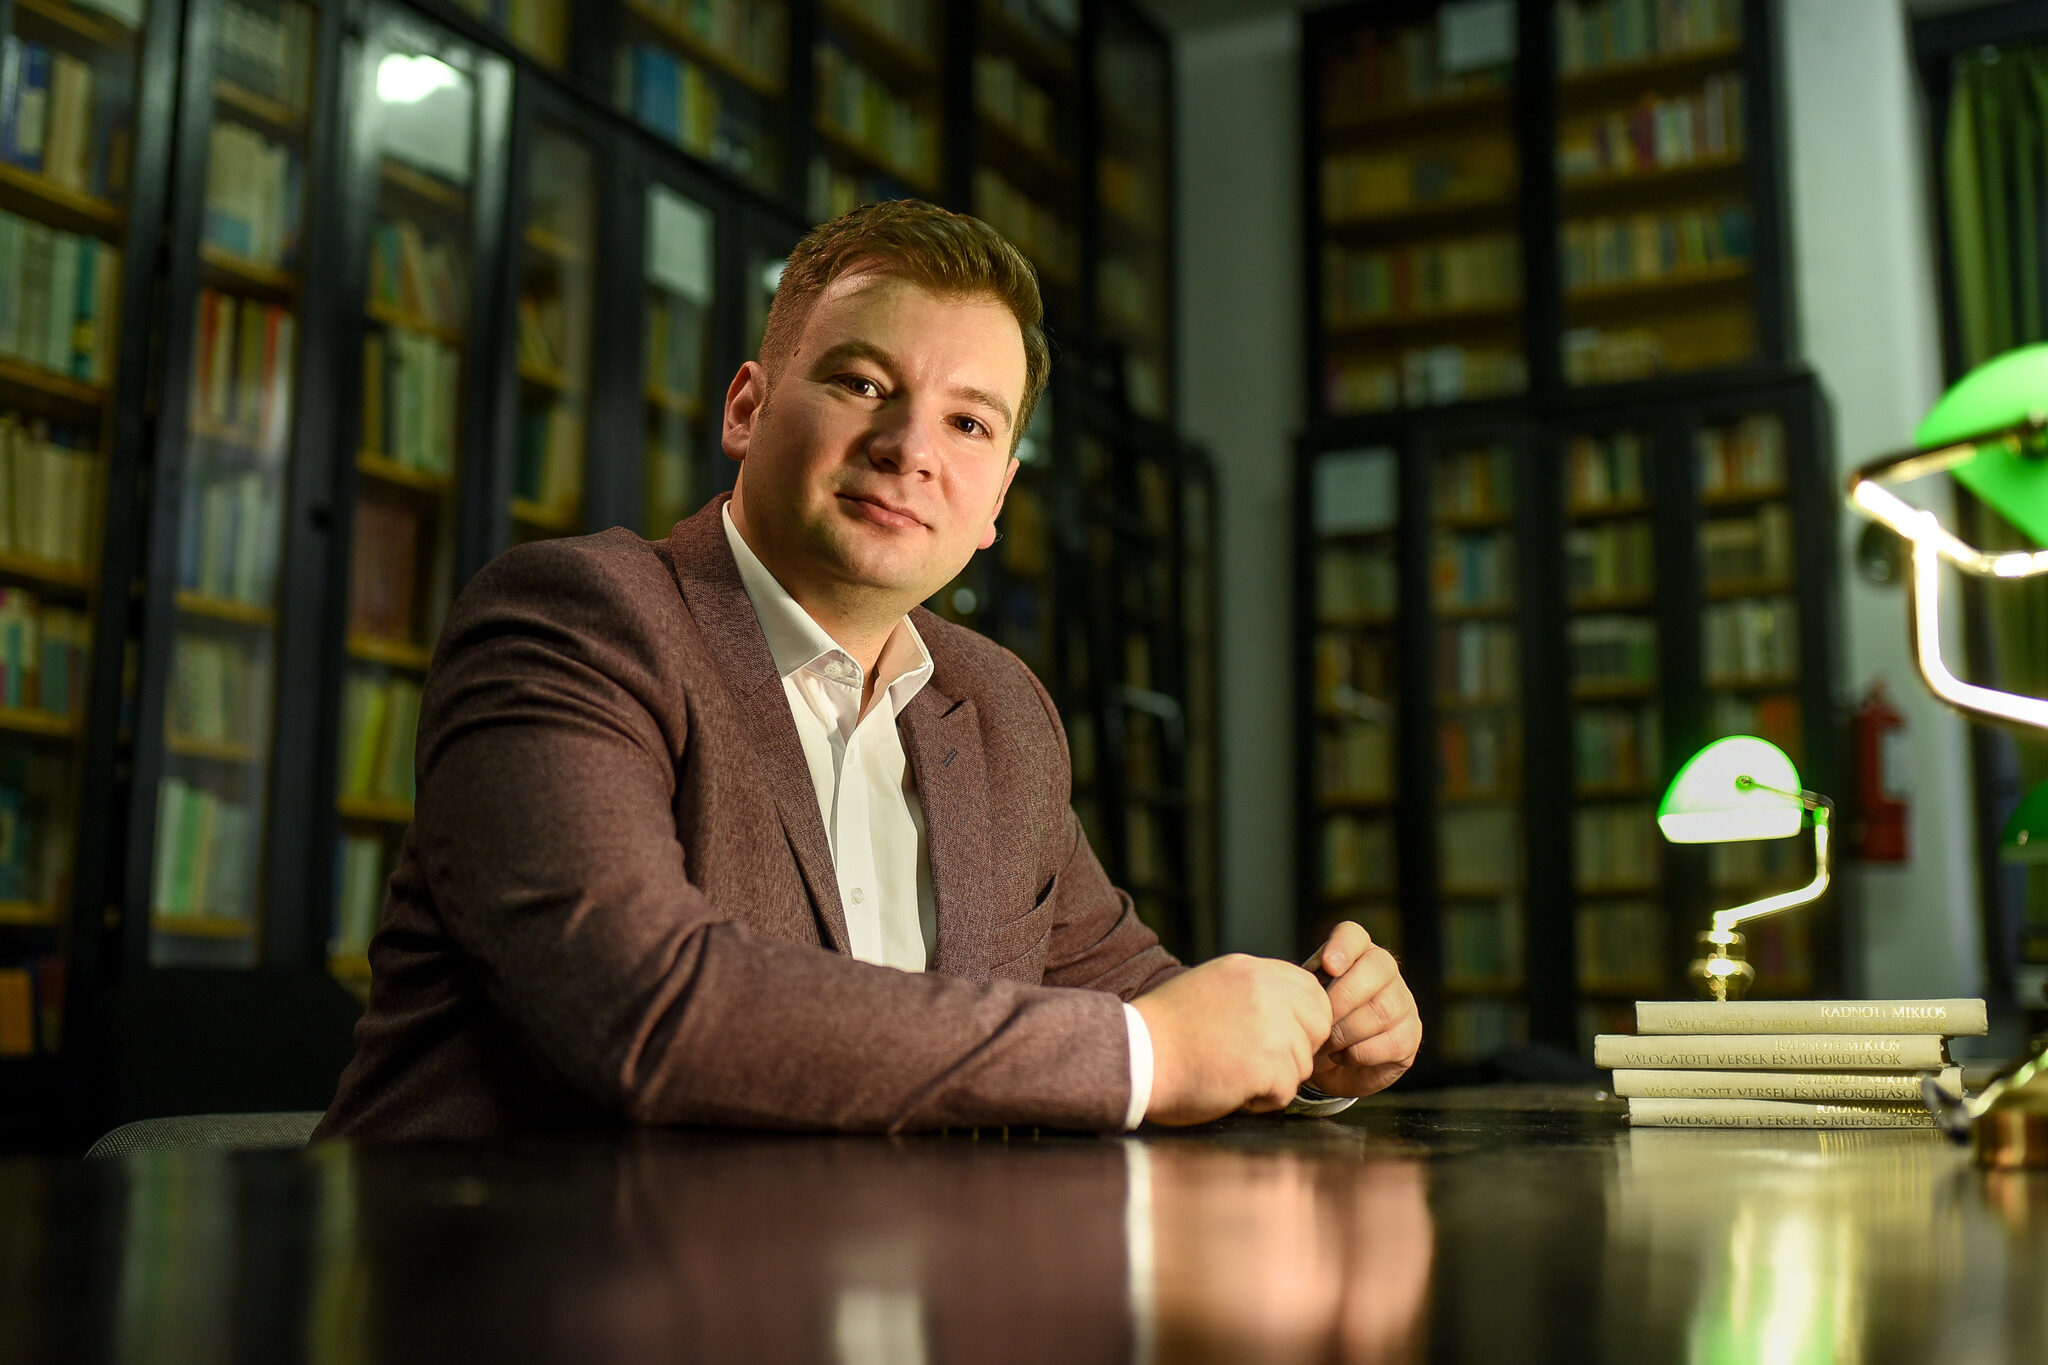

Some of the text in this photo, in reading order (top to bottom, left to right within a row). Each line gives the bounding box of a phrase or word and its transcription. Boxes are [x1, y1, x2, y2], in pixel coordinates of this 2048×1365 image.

[1717, 1053, 1768, 1065] VERSEK
[1737, 1087, 1790, 1099] VERSEK
[1757, 1115, 1809, 1127] VERSEK
